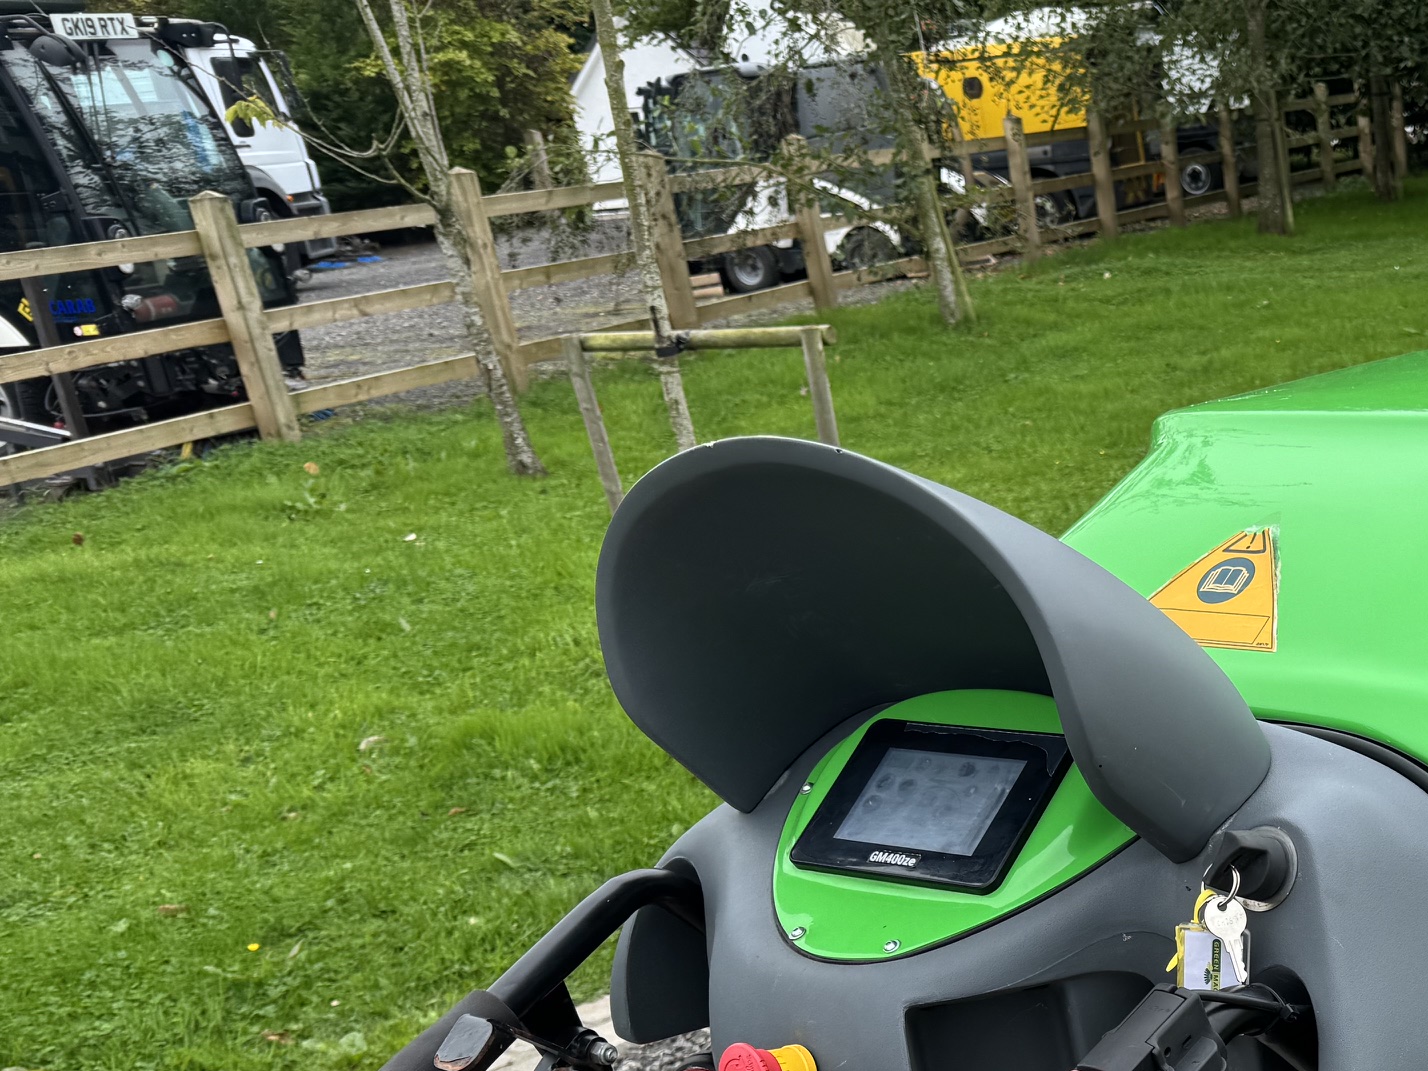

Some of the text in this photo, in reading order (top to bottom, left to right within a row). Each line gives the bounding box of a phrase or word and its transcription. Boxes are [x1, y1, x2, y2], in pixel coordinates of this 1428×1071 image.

[61, 17, 130, 36] GK19 RTX
[869, 850, 917, 867] GM400ze
